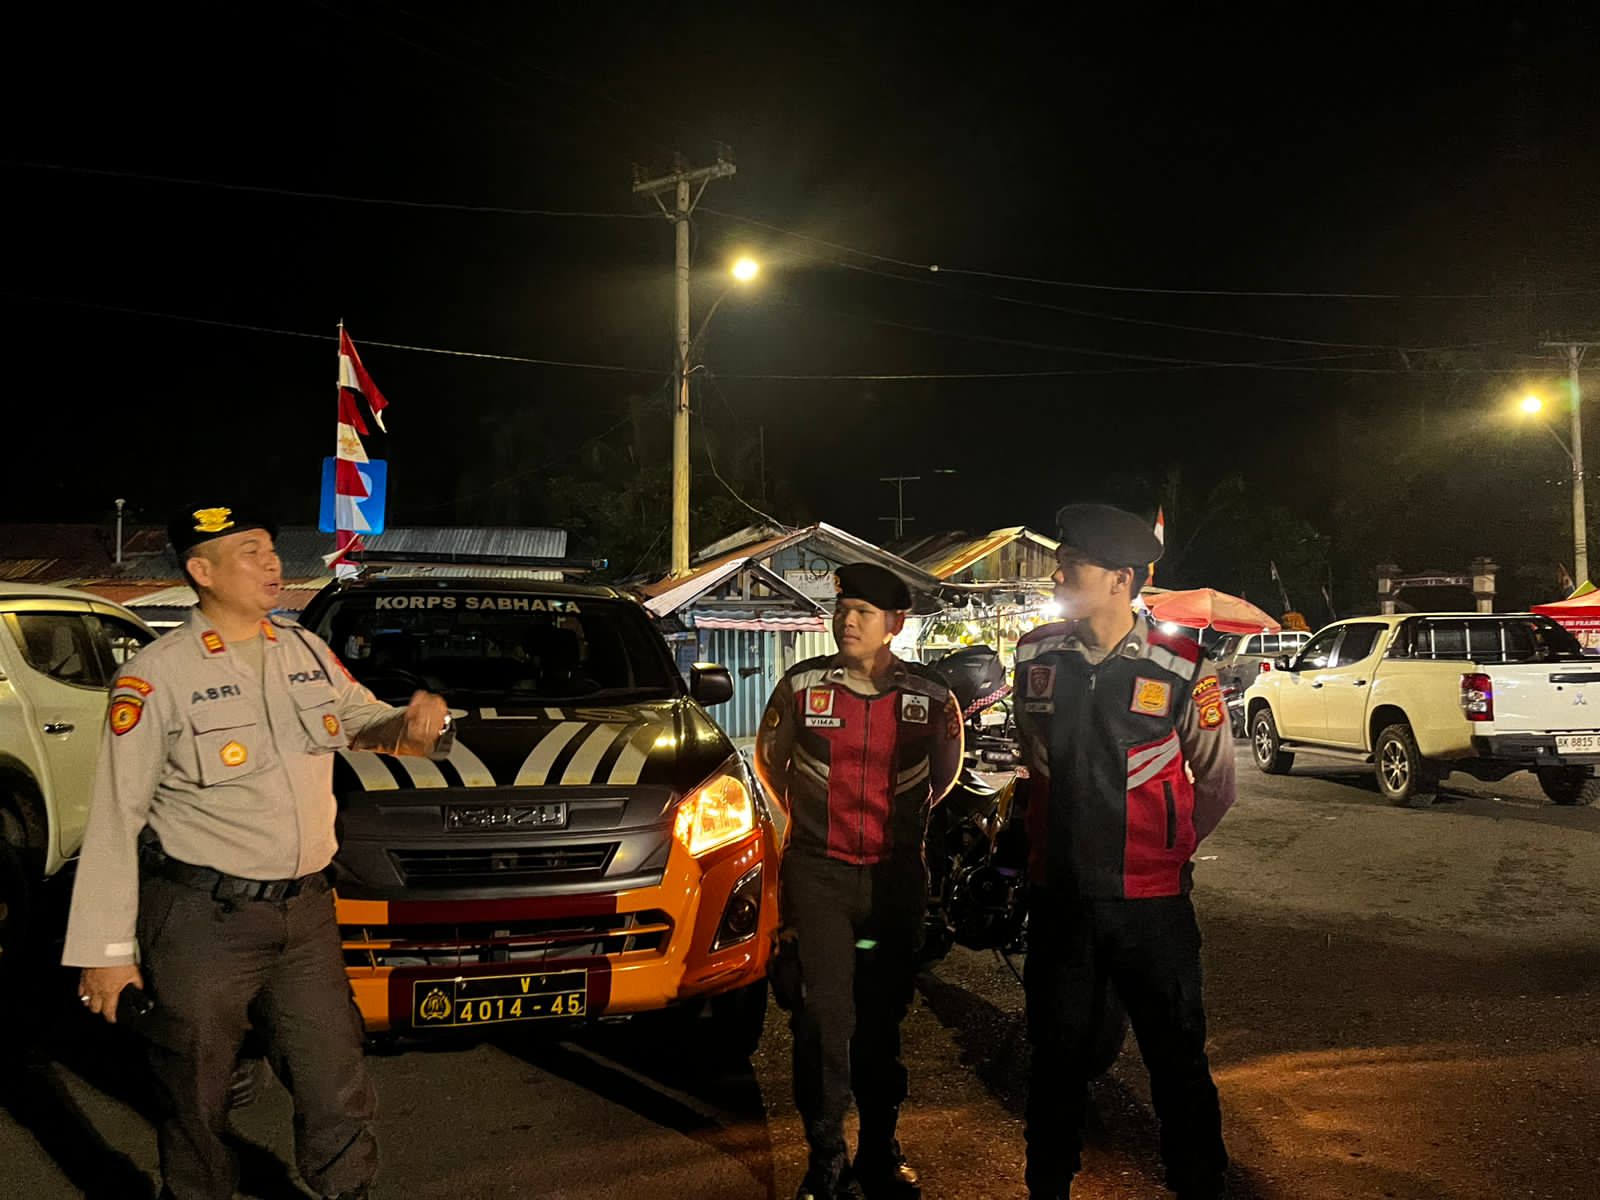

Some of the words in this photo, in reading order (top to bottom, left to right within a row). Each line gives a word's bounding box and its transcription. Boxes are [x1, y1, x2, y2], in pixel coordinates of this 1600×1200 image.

[375, 596, 457, 610] KORPS
[465, 597, 581, 614] SABHARA
[191, 684, 241, 705] ASRI
[520, 977, 531, 993] V
[460, 998, 522, 1022] 4014
[551, 993, 580, 1015] 45
